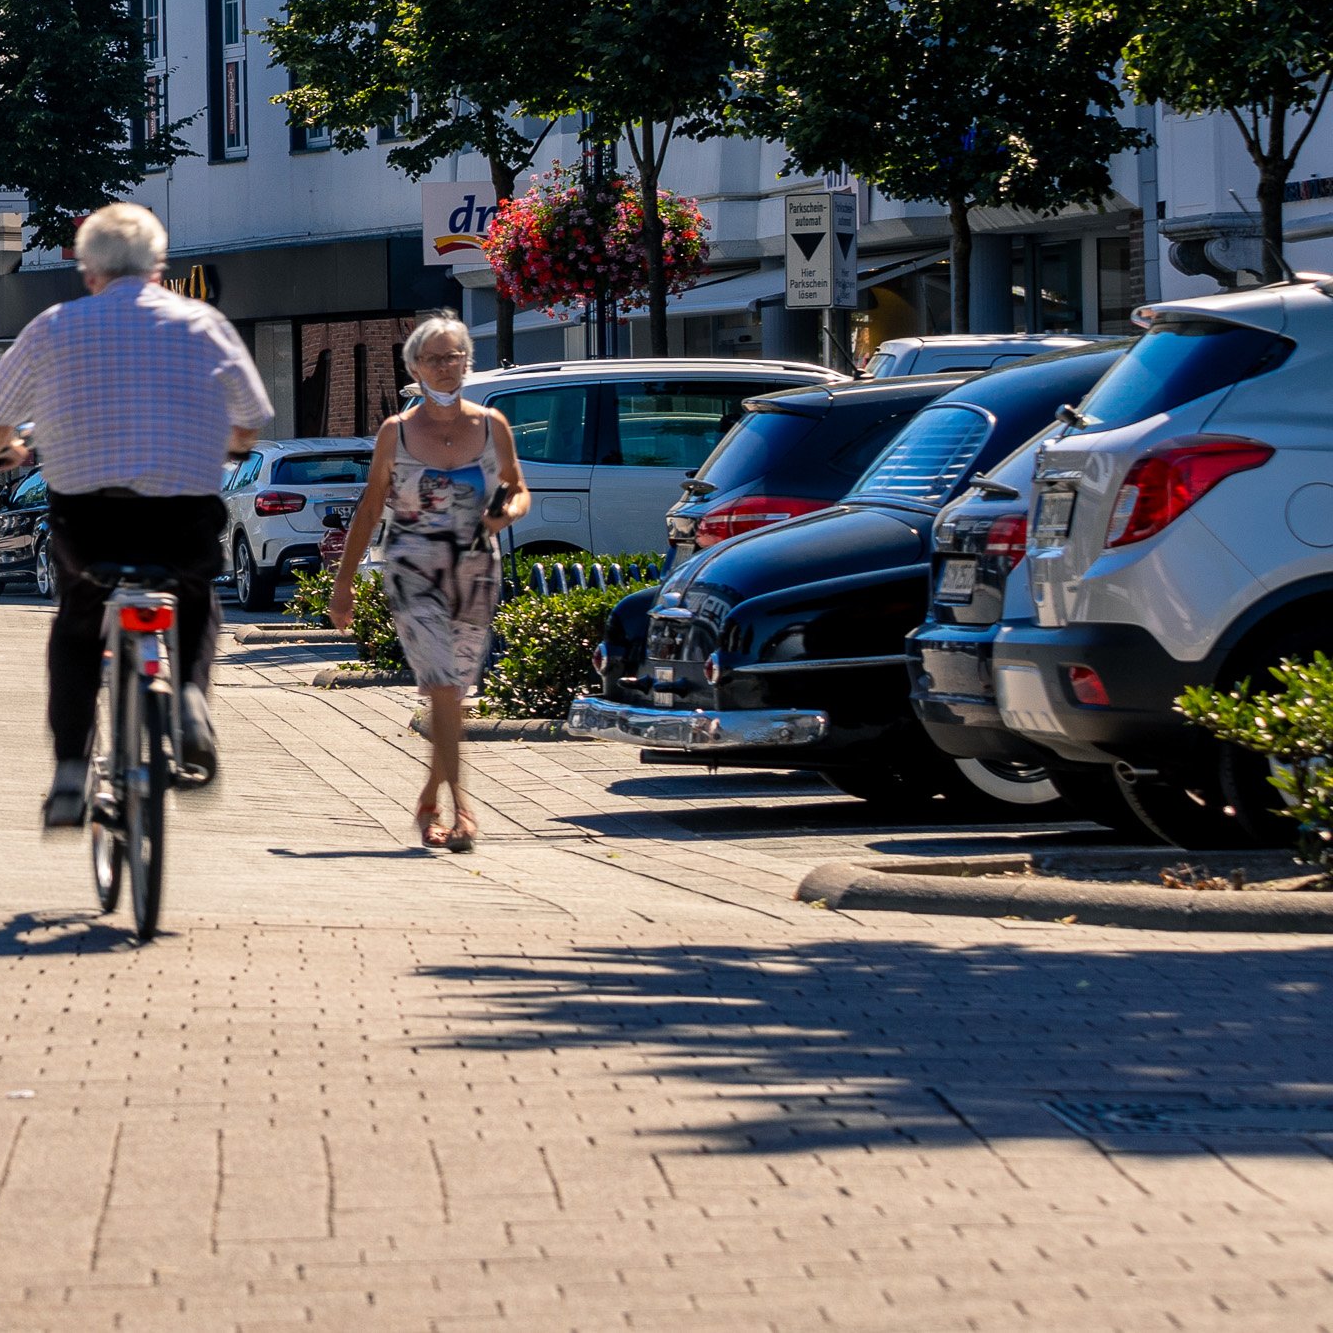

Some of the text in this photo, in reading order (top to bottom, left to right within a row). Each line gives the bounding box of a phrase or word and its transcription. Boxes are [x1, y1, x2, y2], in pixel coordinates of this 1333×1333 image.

[789, 202, 827, 214] Parkschein-
[795, 216, 821, 227] automat
[801, 268, 816, 277] Hier
[790, 279, 828, 289] Parkschein
[798, 290, 818, 300] lösen
